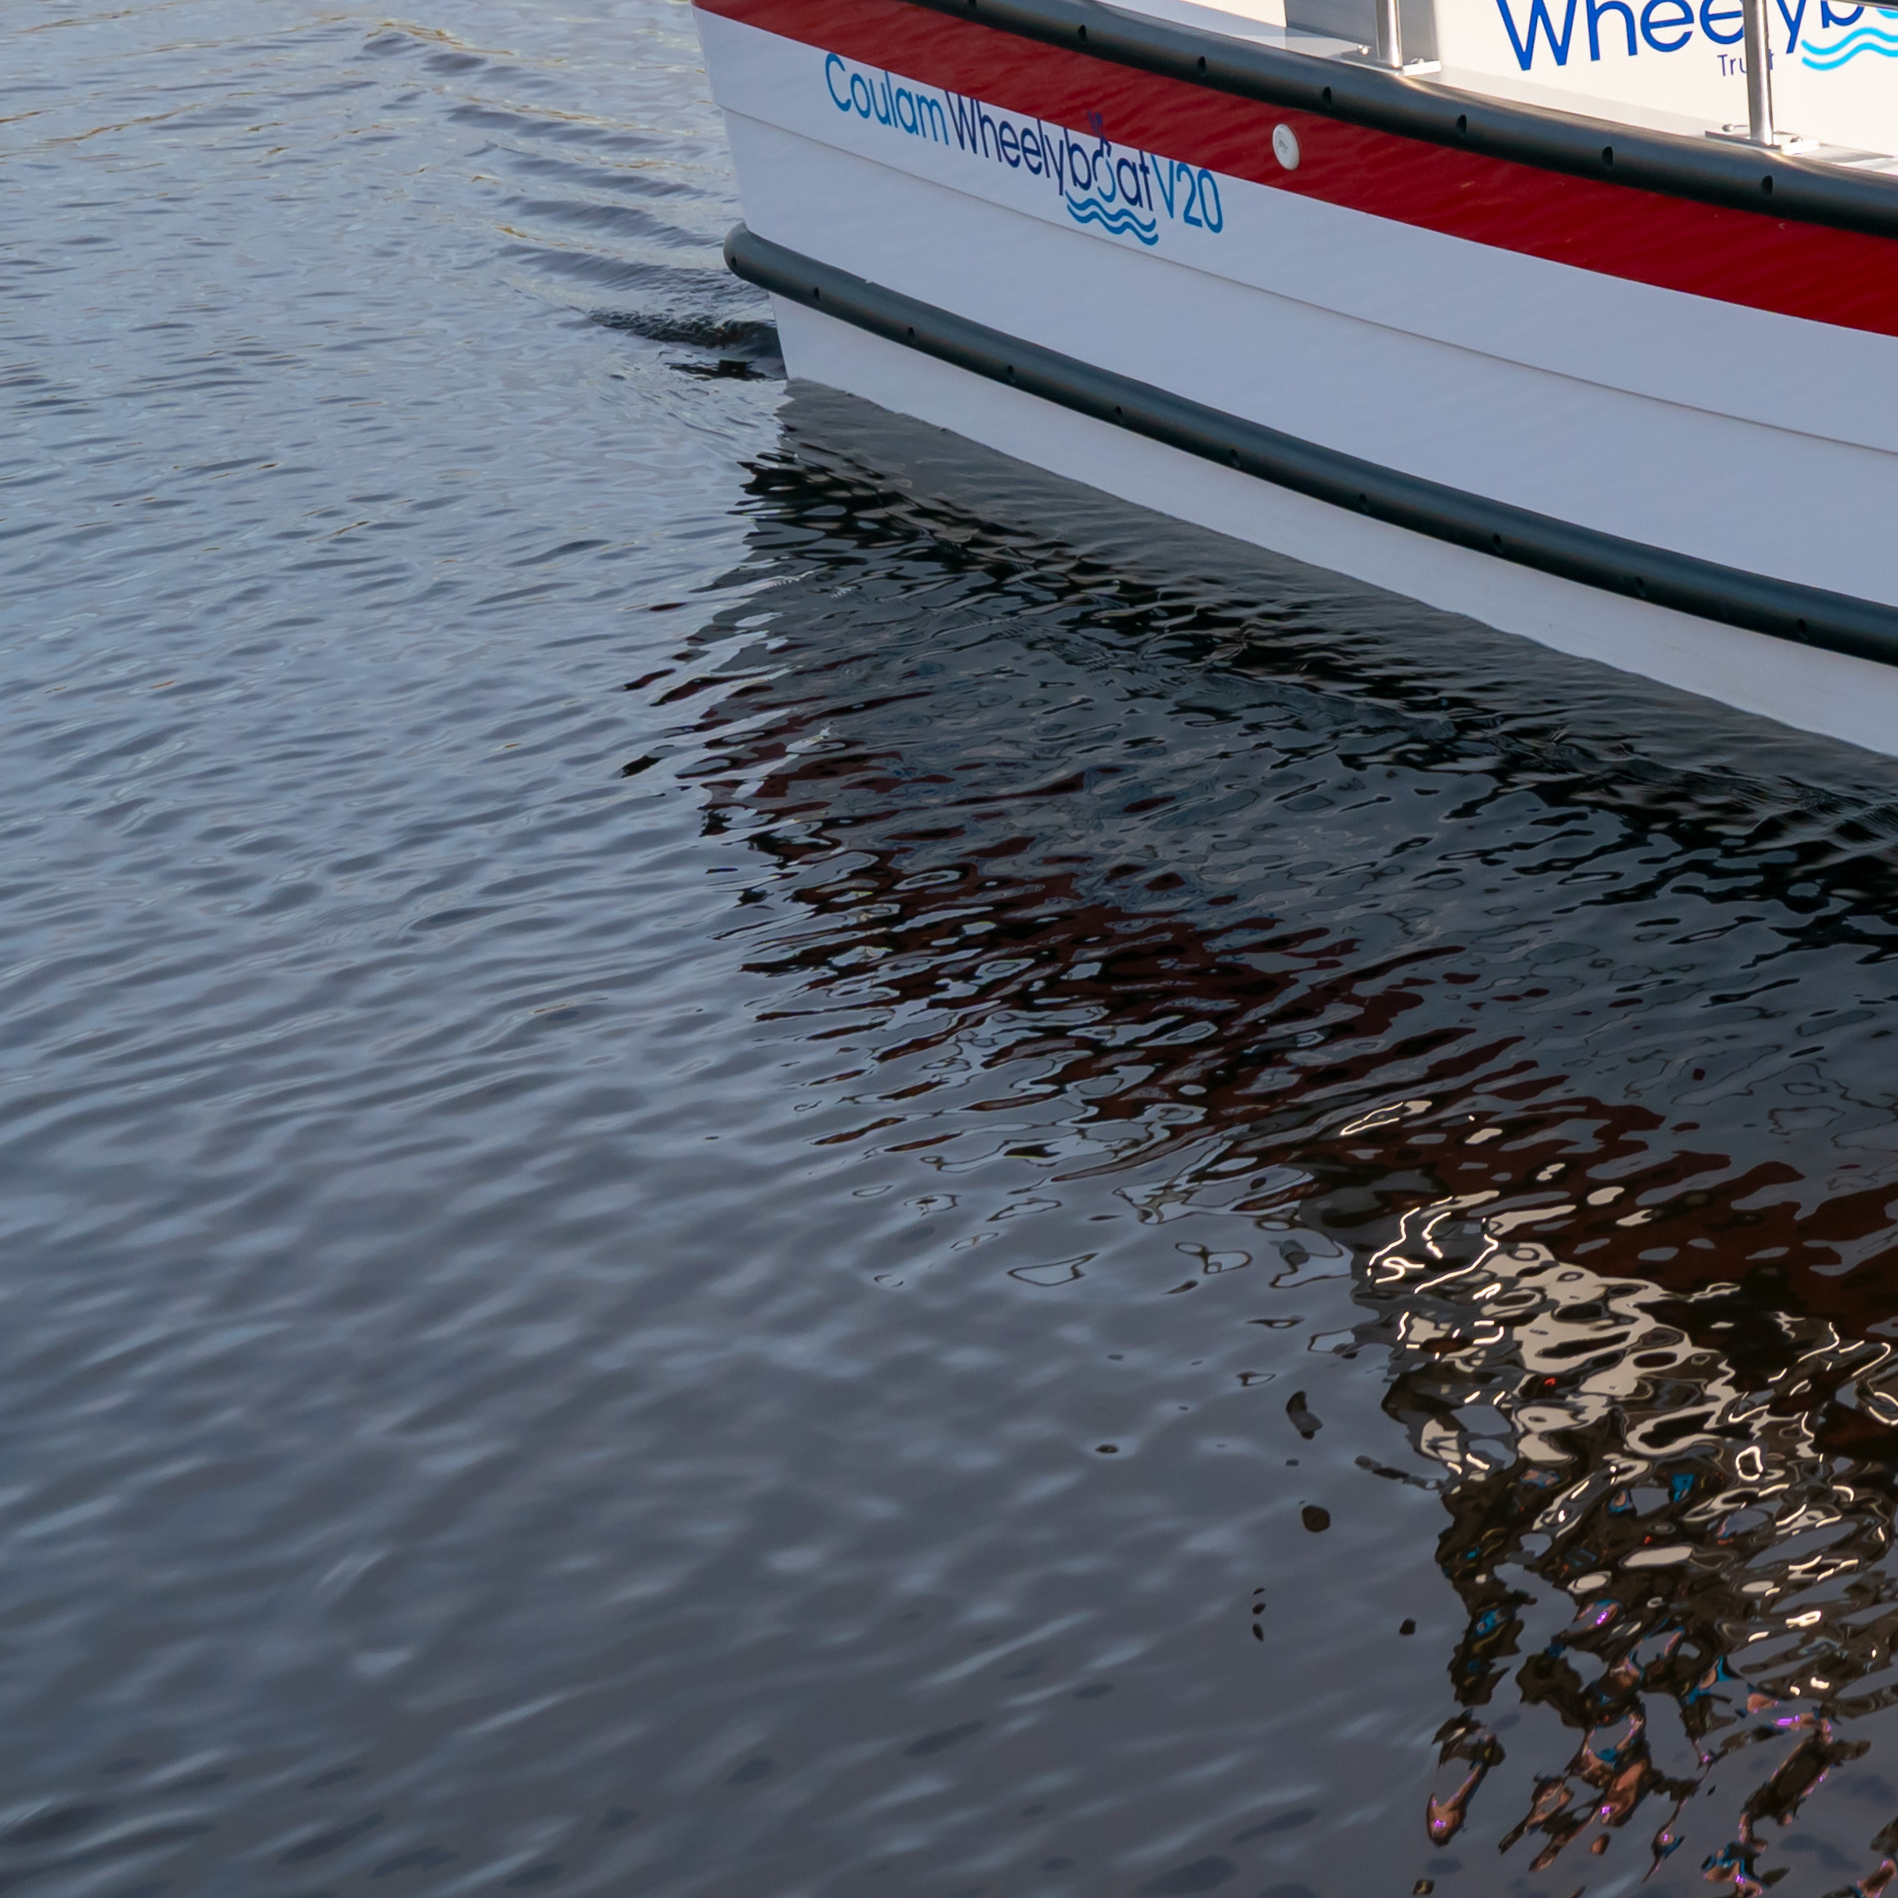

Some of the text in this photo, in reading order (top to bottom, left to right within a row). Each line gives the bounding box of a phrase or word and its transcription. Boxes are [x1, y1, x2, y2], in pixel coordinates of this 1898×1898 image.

[1717, 49, 1774, 77] Trut
[825, 53, 1223, 234] Coulam Wheelyboat V20
